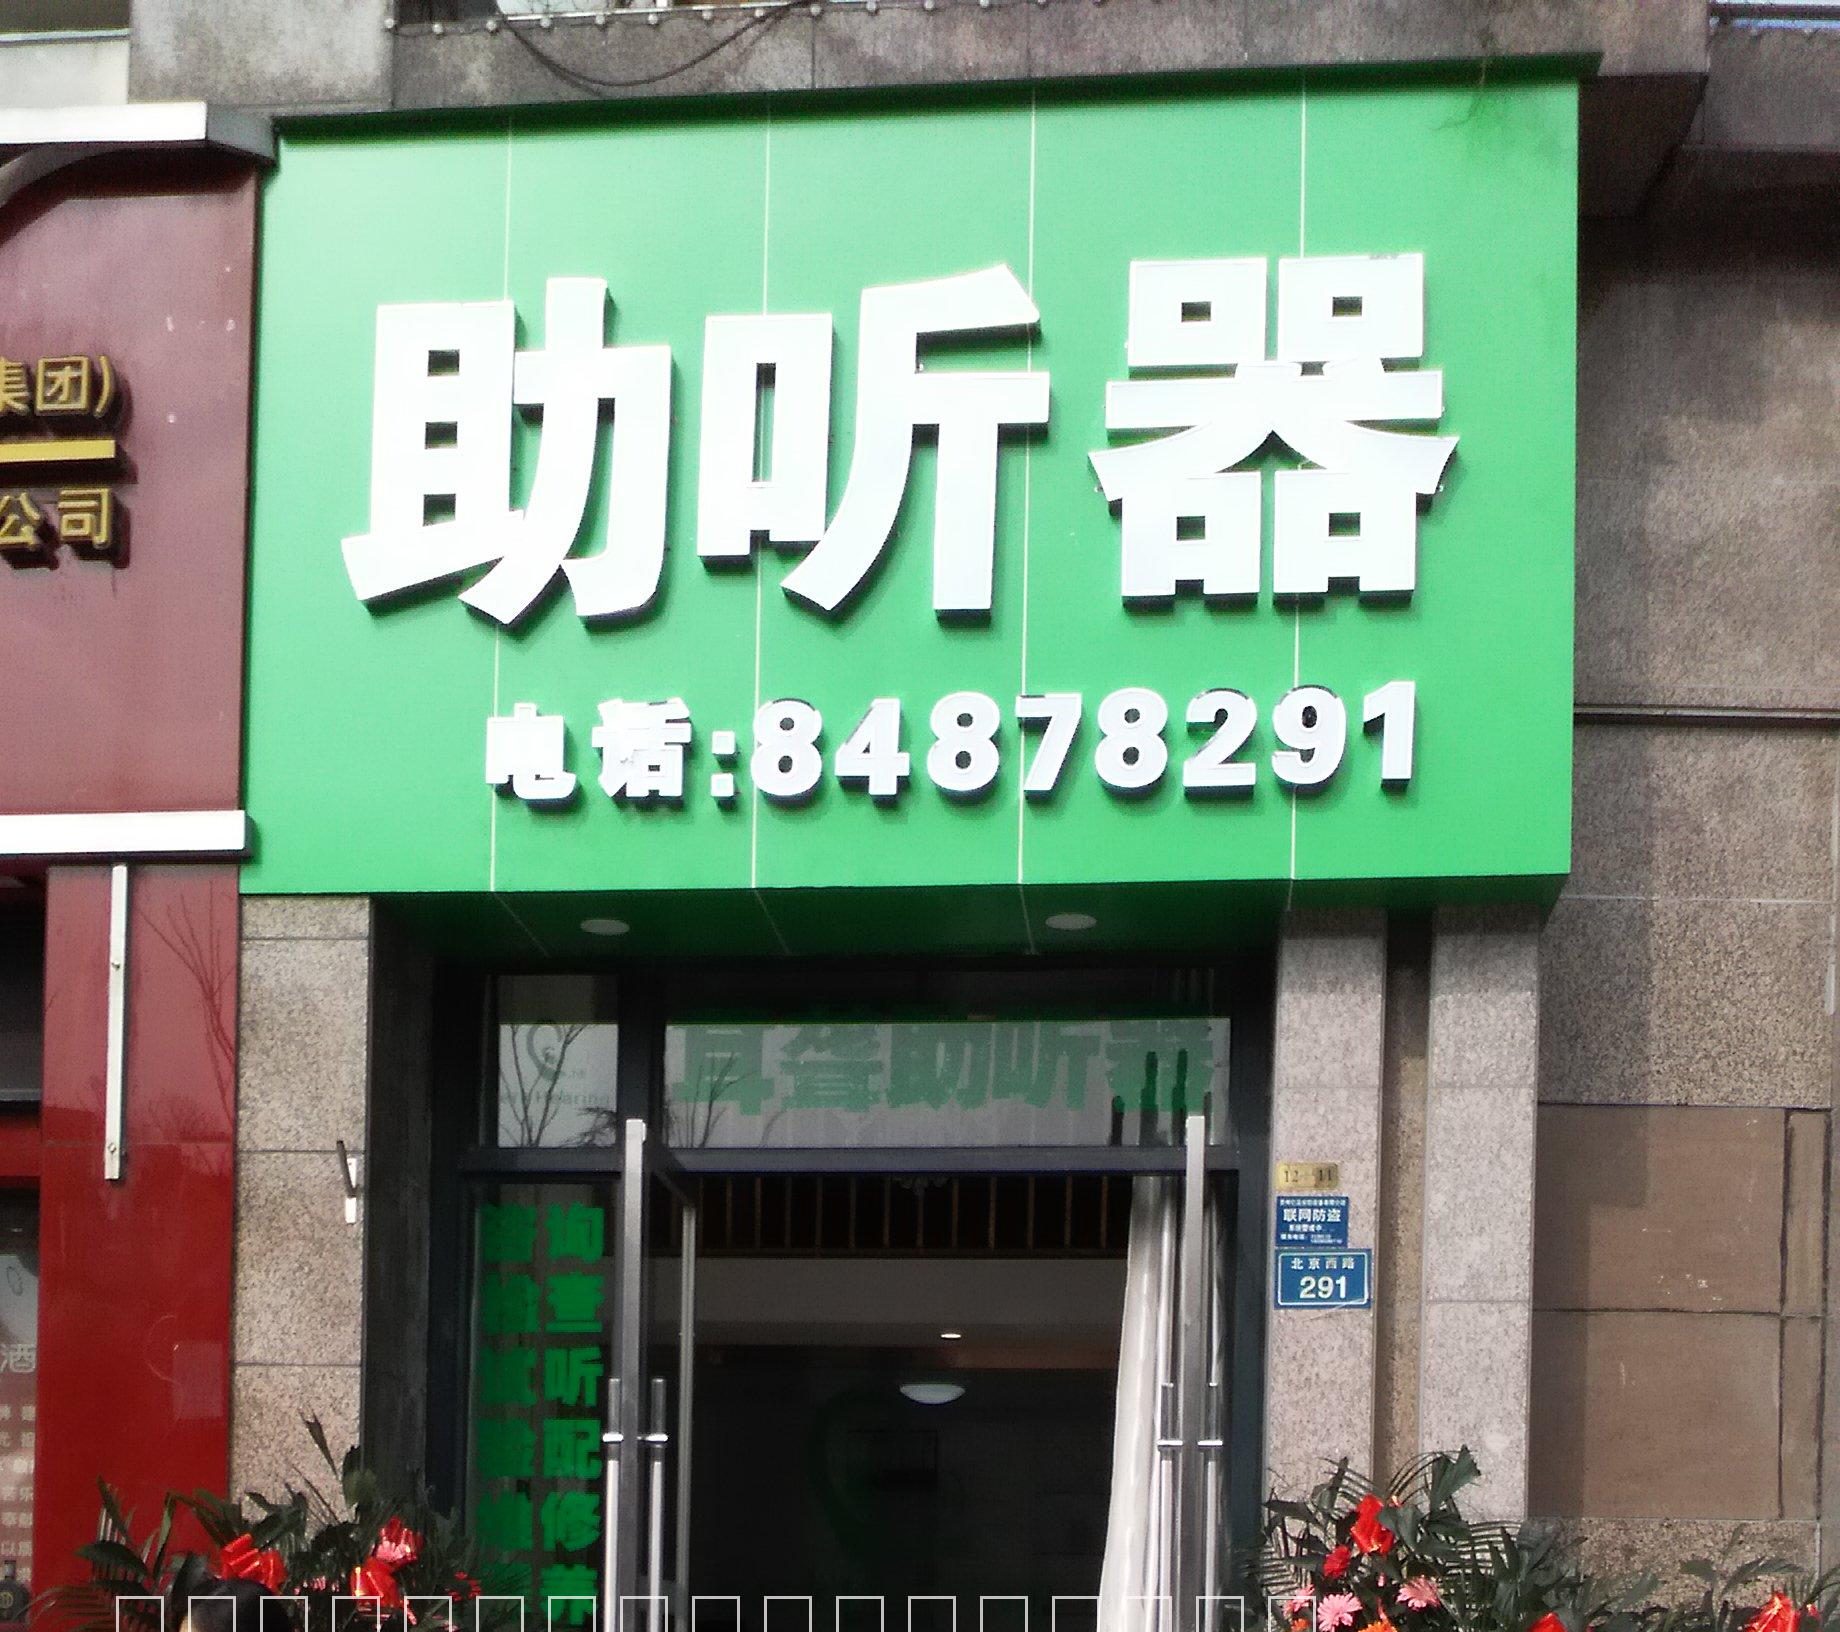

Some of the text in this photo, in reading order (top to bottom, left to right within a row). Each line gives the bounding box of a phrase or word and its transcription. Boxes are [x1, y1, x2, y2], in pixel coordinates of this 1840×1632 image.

[342, 252, 1460, 625] 助听器
[0, 486, 112, 548] 公司
[1282, 1208, 1341, 1223] 联网防盗
[1291, 1257, 1355, 1270] 北京西路
[1299, 1275, 1347, 1299] 291
